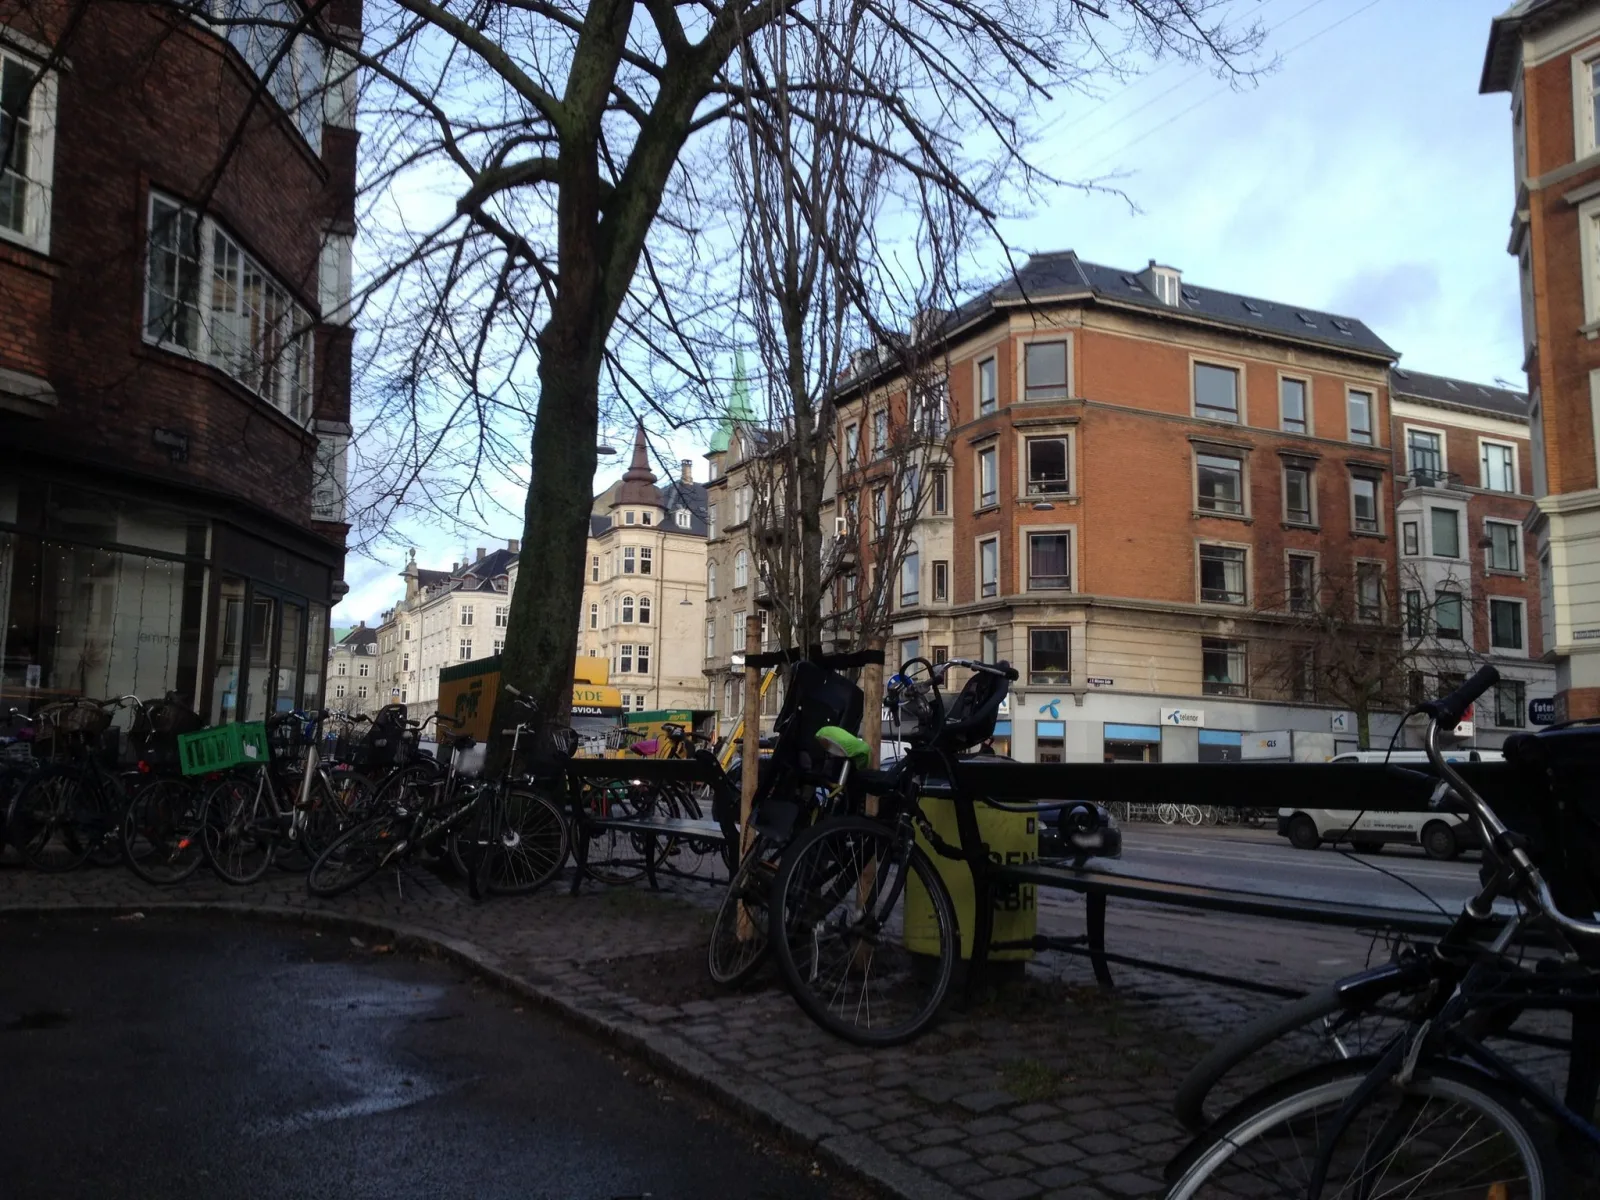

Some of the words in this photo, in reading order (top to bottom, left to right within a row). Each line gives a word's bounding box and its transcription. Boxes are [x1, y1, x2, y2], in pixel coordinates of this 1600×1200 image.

[573, 690, 603, 702] YDE
[571, 706, 602, 714] SVIOLA
[1179, 713, 1199, 722] telenor
